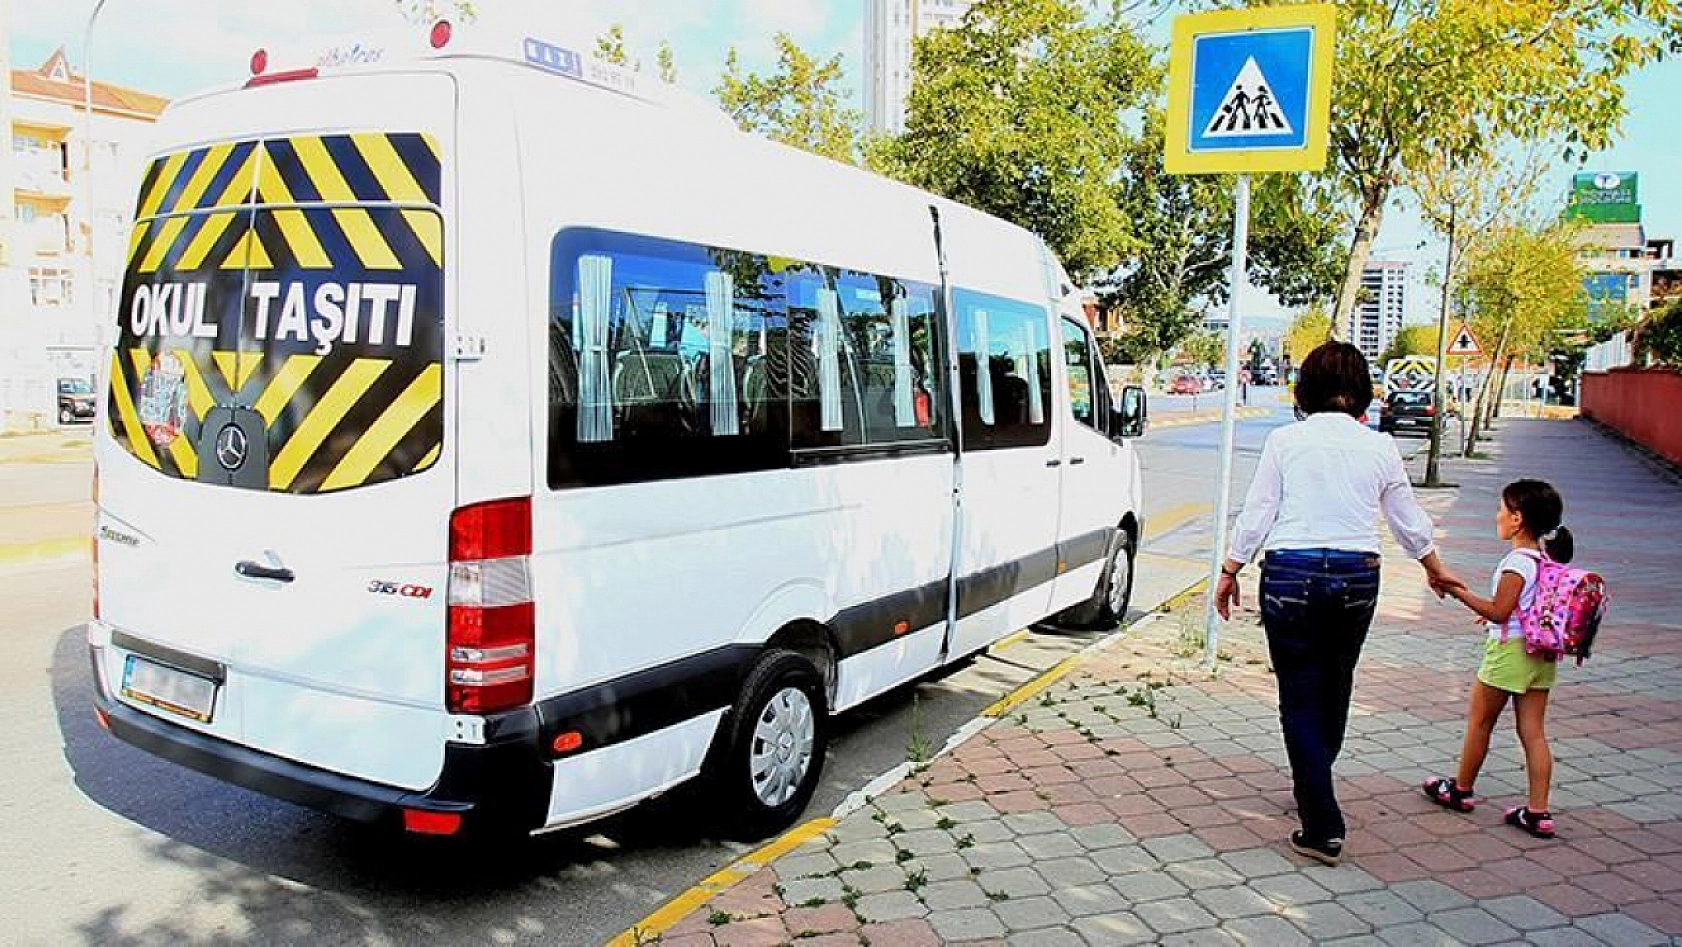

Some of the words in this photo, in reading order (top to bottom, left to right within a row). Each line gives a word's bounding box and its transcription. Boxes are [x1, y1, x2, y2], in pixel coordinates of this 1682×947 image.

[131, 282, 218, 338] OKUL
[251, 281, 417, 355] TAŞITI
[400, 583, 433, 599] CDI
